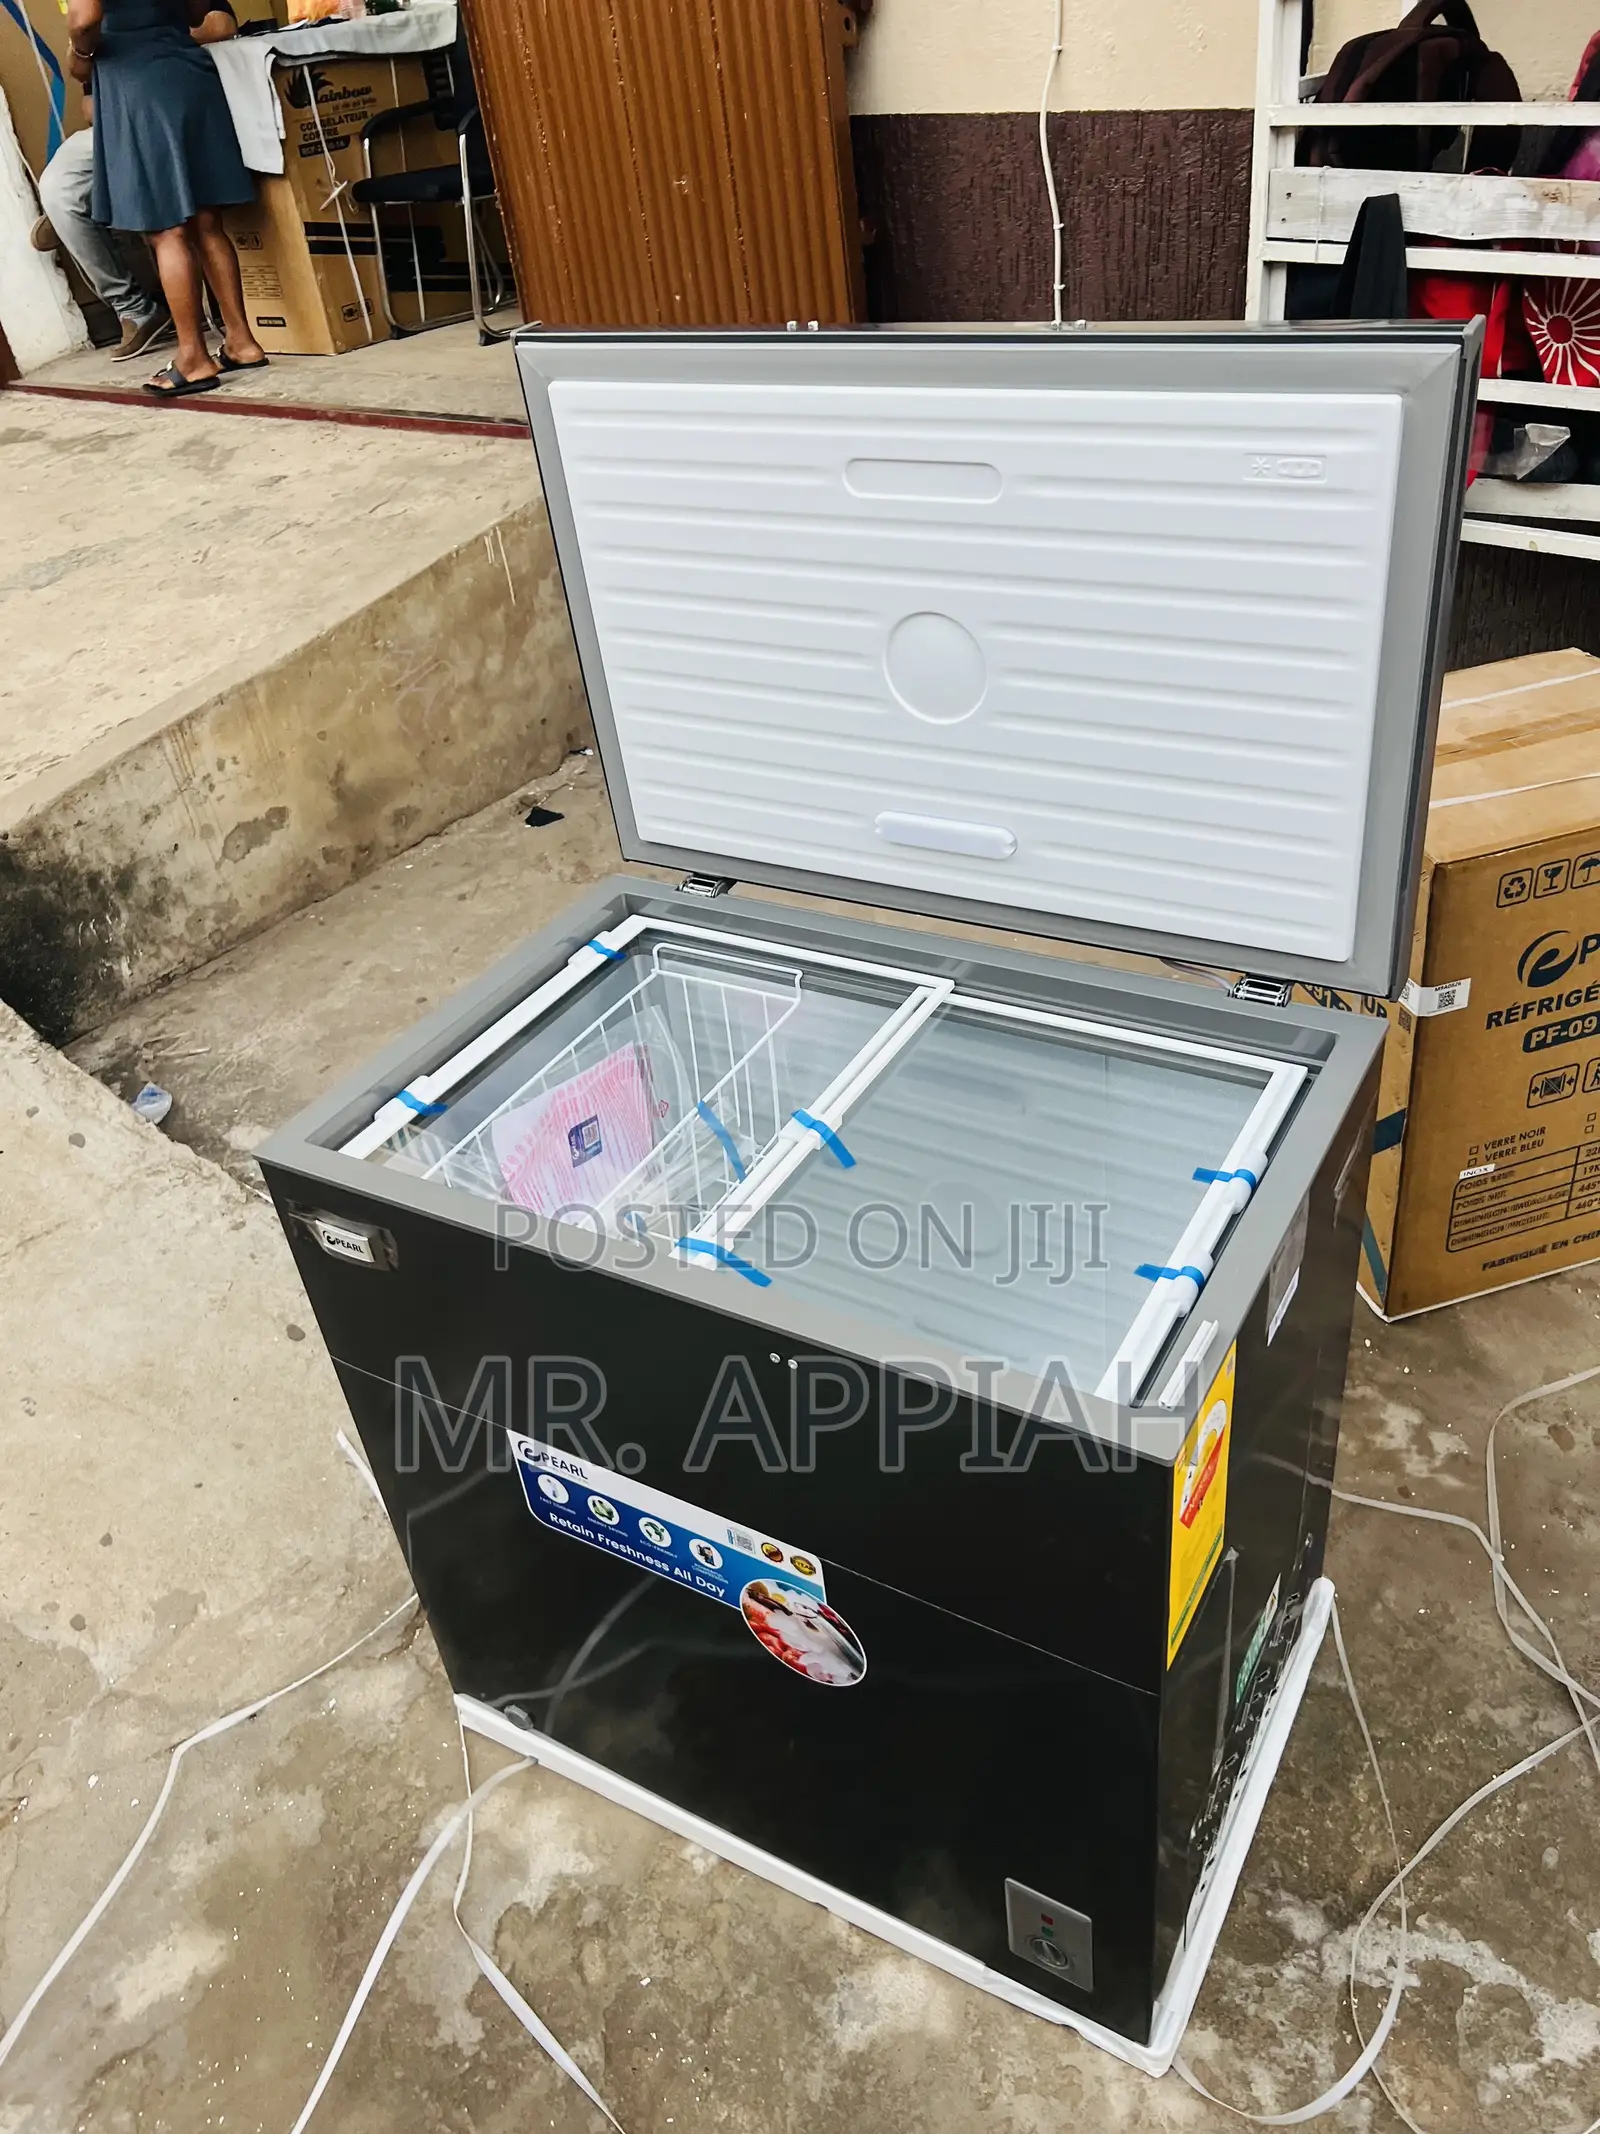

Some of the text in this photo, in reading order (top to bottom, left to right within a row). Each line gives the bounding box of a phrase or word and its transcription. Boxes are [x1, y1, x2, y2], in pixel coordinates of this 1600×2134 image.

[1485, 980, 1600, 1030] RÉFRIGÉ
[1530, 1015, 1598, 1049] PF-09
[1484, 1126, 1546, 1151] VERRE NOIR
[1485, 1139, 1544, 1162] VERRE BLEU
[1463, 1167, 1489, 1177] INOX
[1550, 1239, 1569, 1250] EN
[549, 1511, 726, 1598] Retain Freshness All Day
